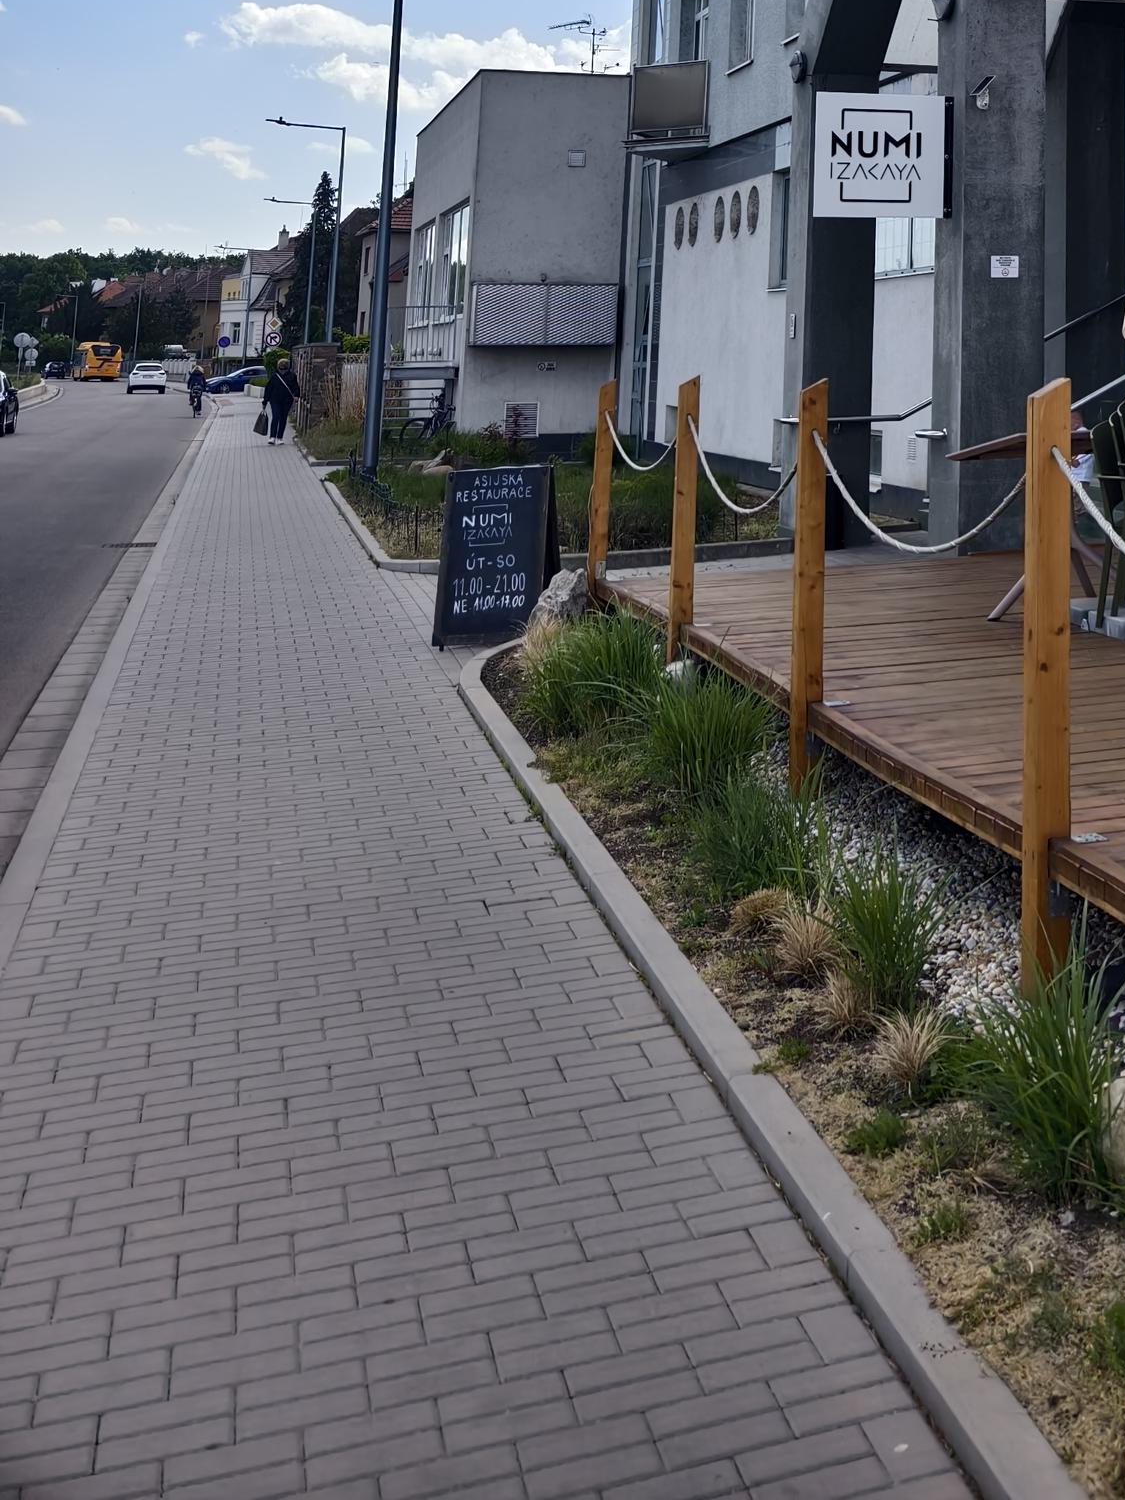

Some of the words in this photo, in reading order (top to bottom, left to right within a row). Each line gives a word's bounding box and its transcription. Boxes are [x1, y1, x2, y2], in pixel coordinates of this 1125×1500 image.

[831, 130, 922, 159] NUMI
[474, 469, 524, 487] ASIJSKÁ
[456, 486, 533, 503] RESTAURACE
[462, 512, 512, 528] NUMI
